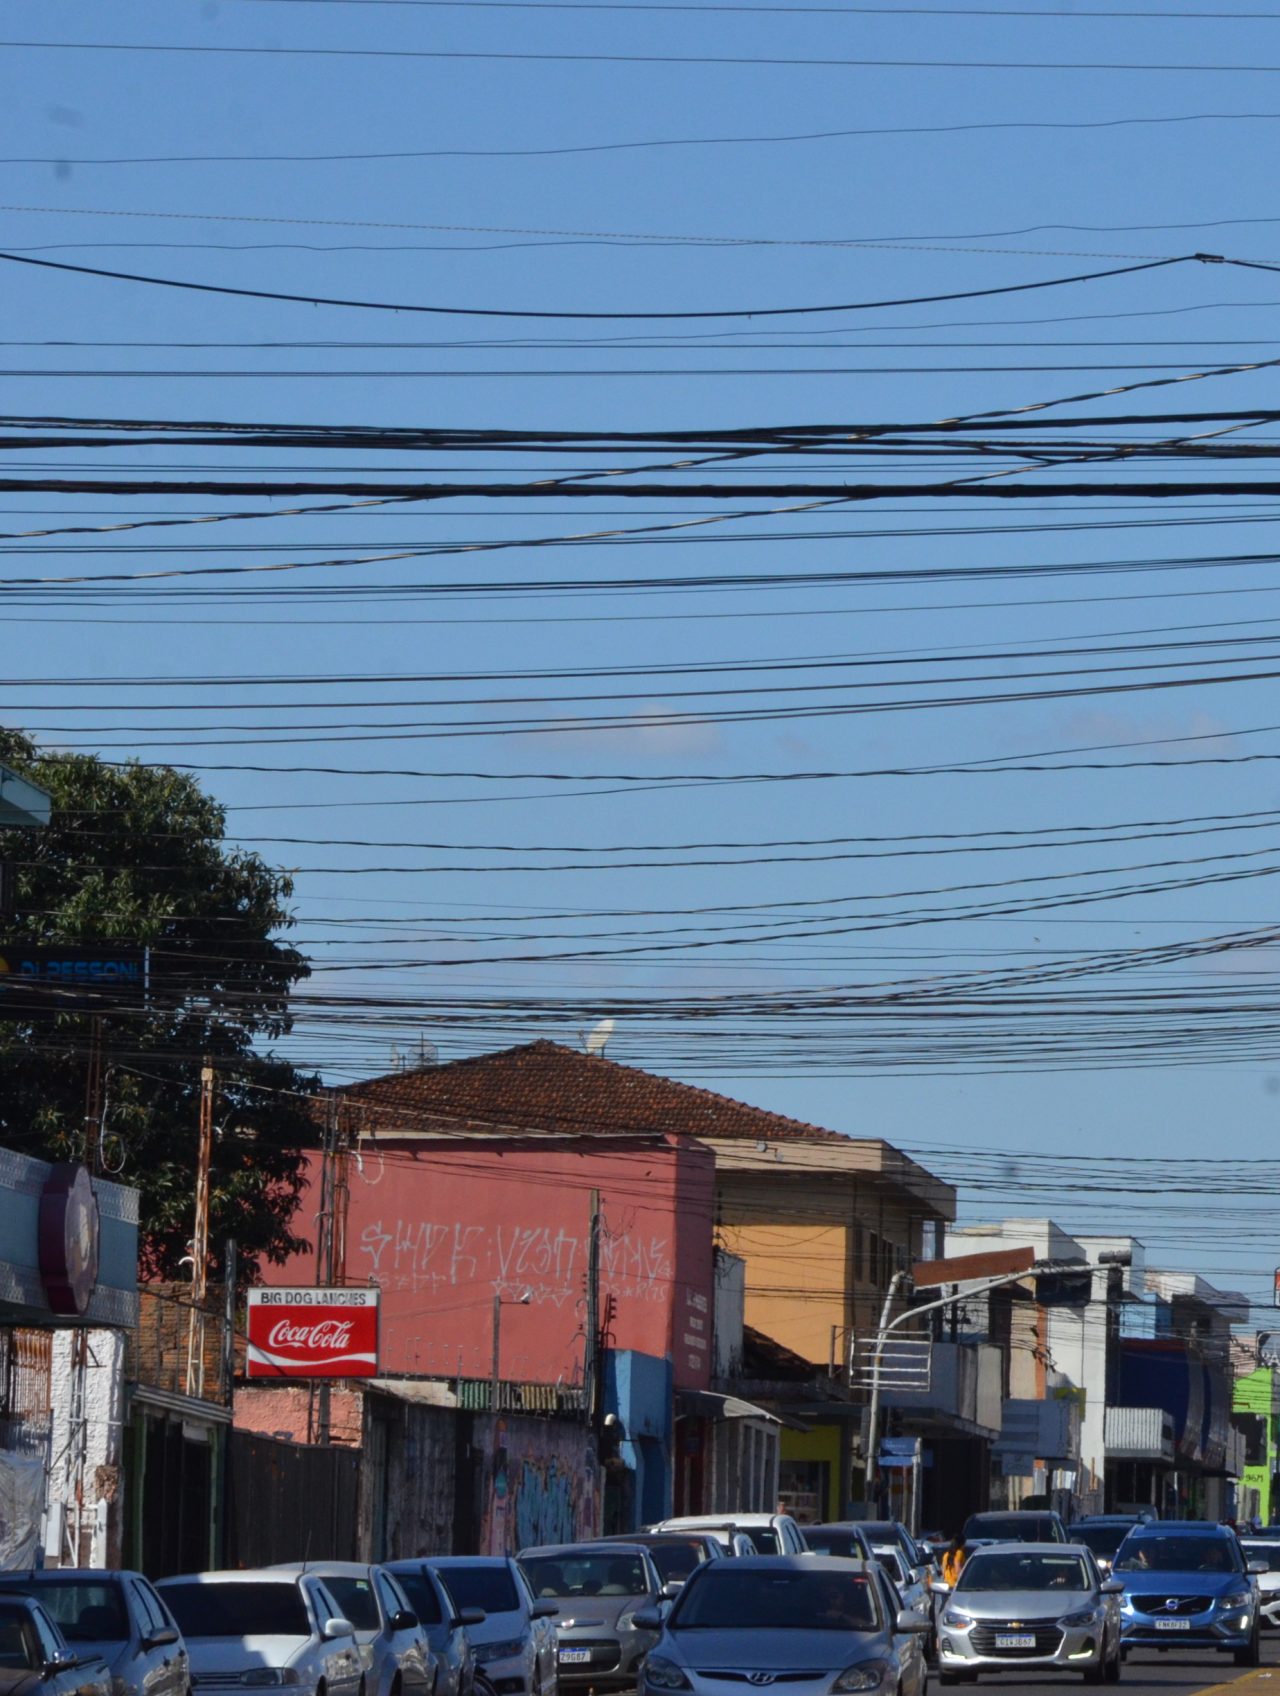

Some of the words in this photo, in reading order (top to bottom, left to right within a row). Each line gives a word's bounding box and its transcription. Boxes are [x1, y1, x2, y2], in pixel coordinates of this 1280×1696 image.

[261, 1292, 282, 1304] BIG
[285, 1292, 312, 1304] DOG
[316, 1293, 366, 1305] LANCHES
[268, 1319, 355, 1348] Coca-Cola
